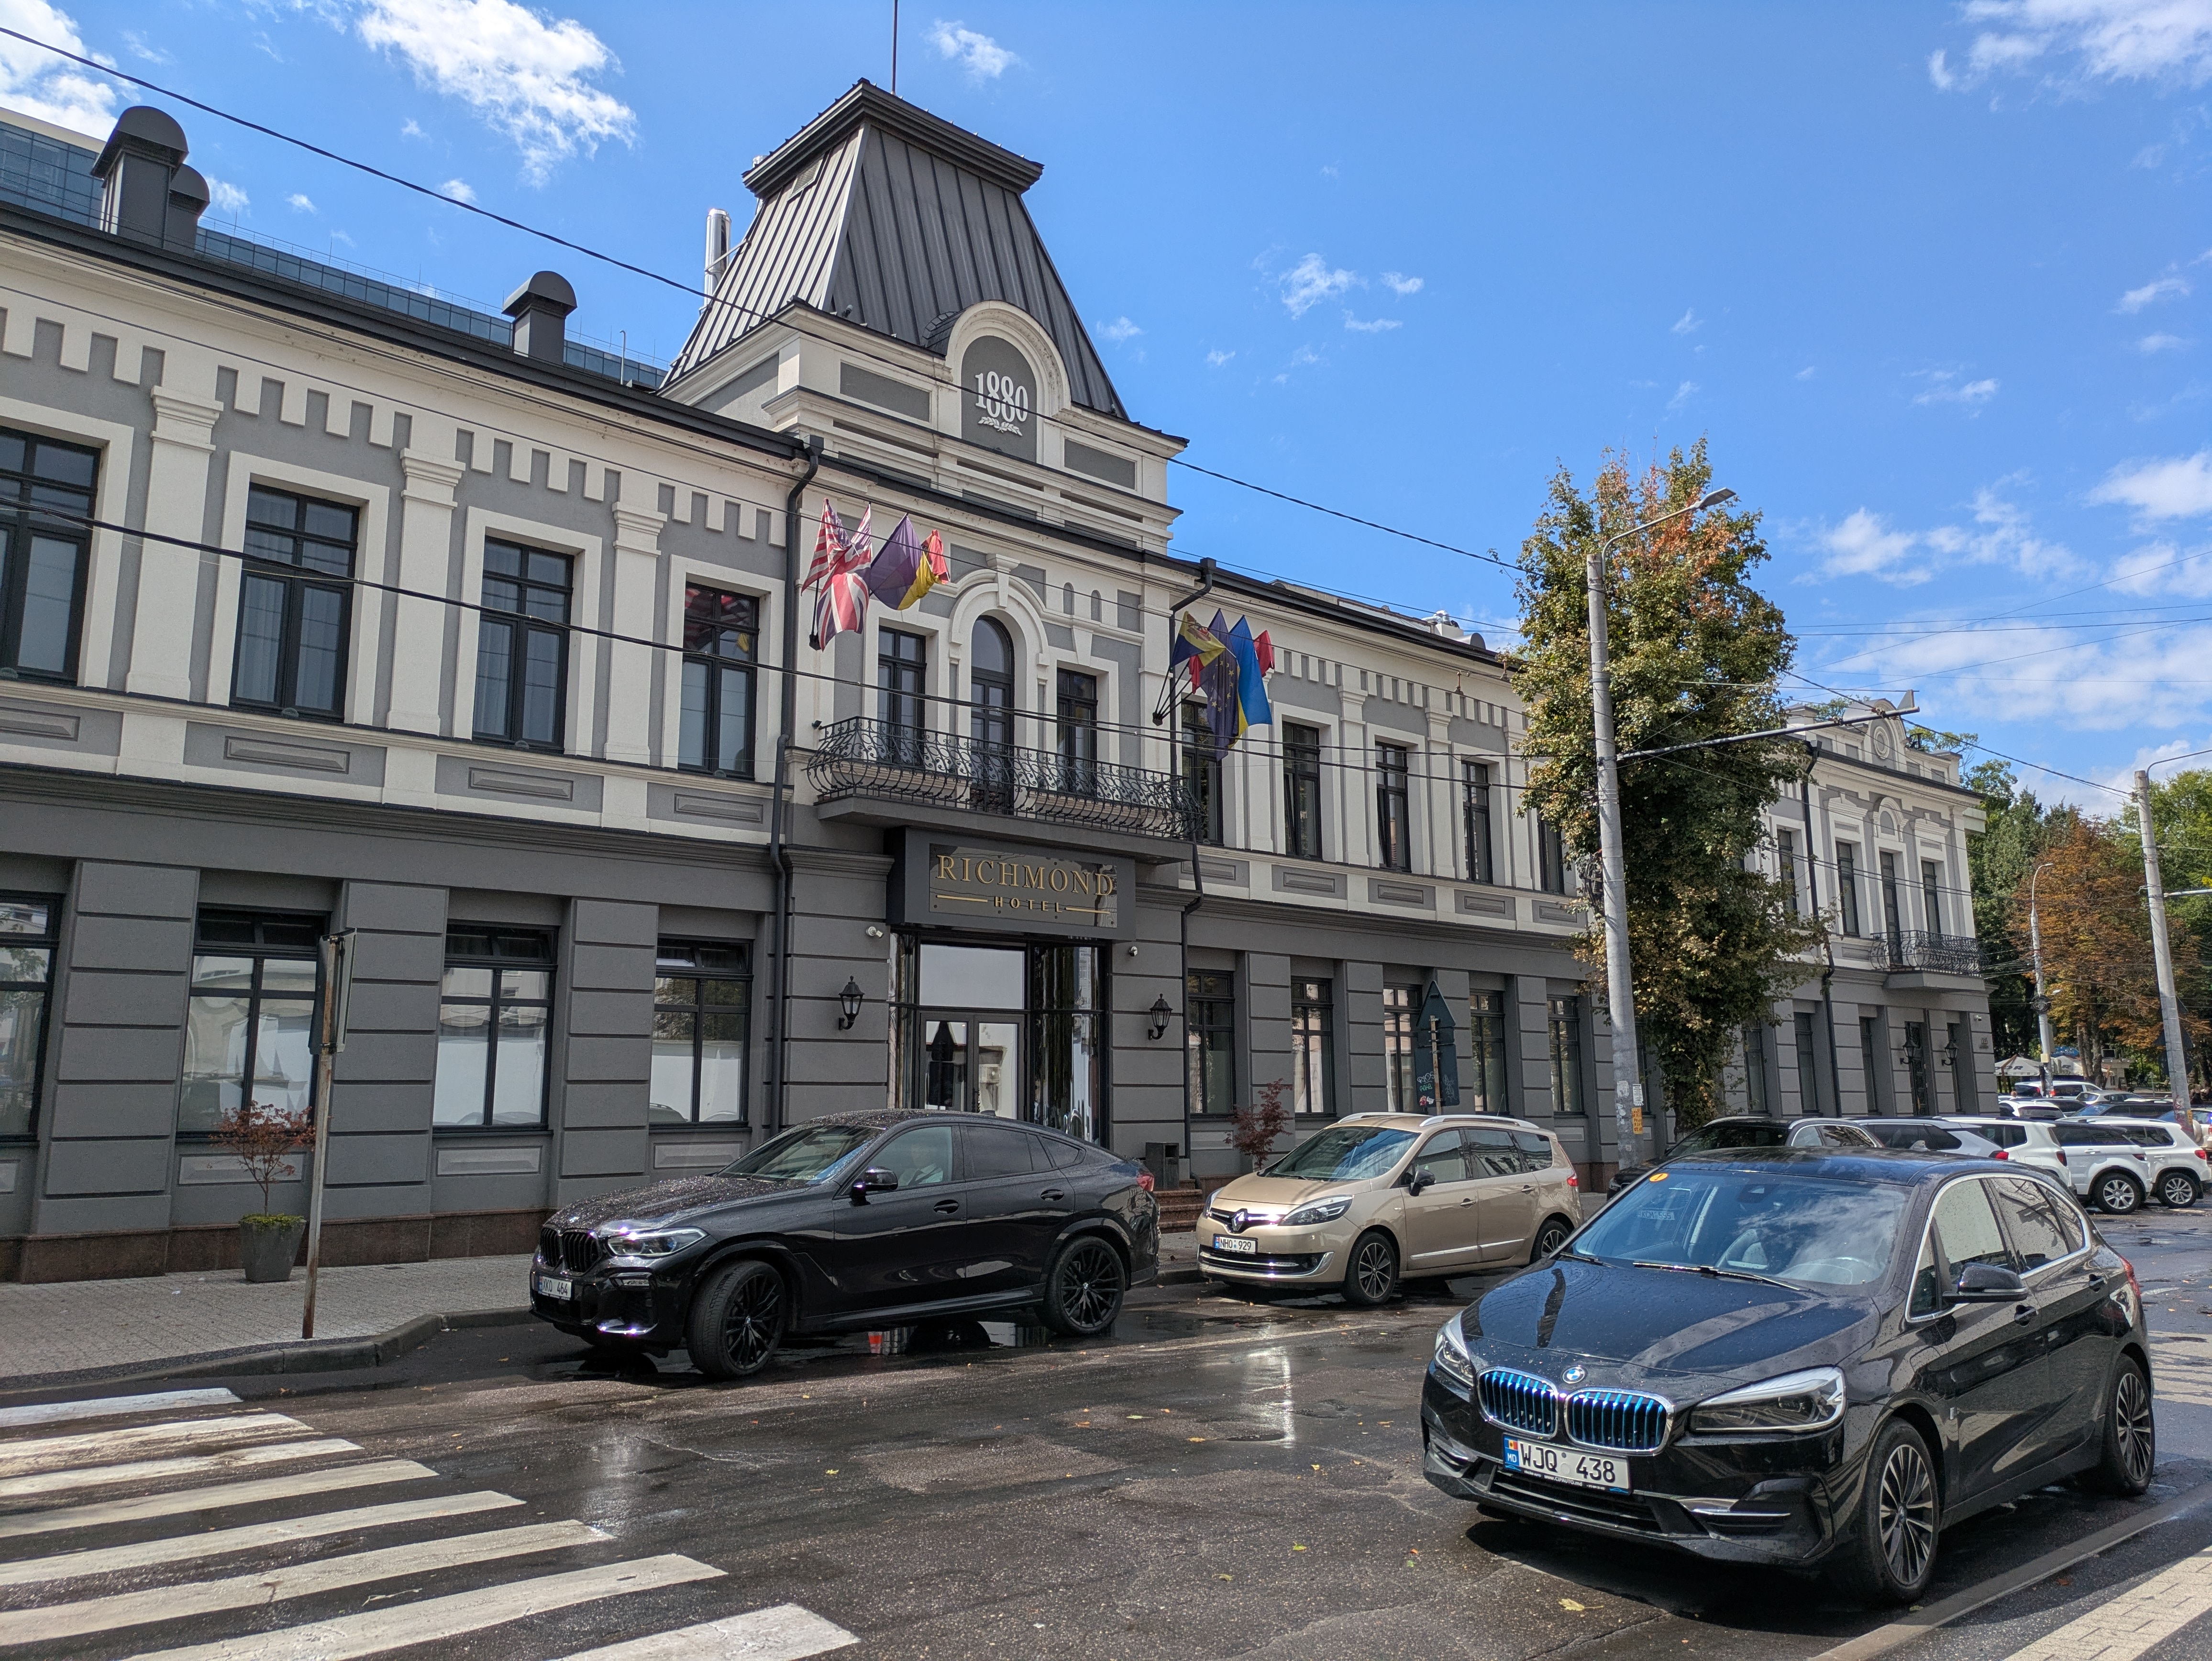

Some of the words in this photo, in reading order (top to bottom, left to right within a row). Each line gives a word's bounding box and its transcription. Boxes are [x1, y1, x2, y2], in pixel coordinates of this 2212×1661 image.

[974, 371, 1029, 422] 1880
[936, 854, 1114, 896] RICHMOND
[994, 896, 1062, 913] HOTEL
[1220, 1238, 1233, 1249] NHO
[1238, 1240, 1252, 1251] 929
[543, 1278, 553, 1292] XKO
[557, 1282, 568, 1296] 464
[1507, 1452, 1517, 1463] MD
[1519, 1443, 1558, 1473] WJQ
[1576, 1456, 1615, 1483] 438
